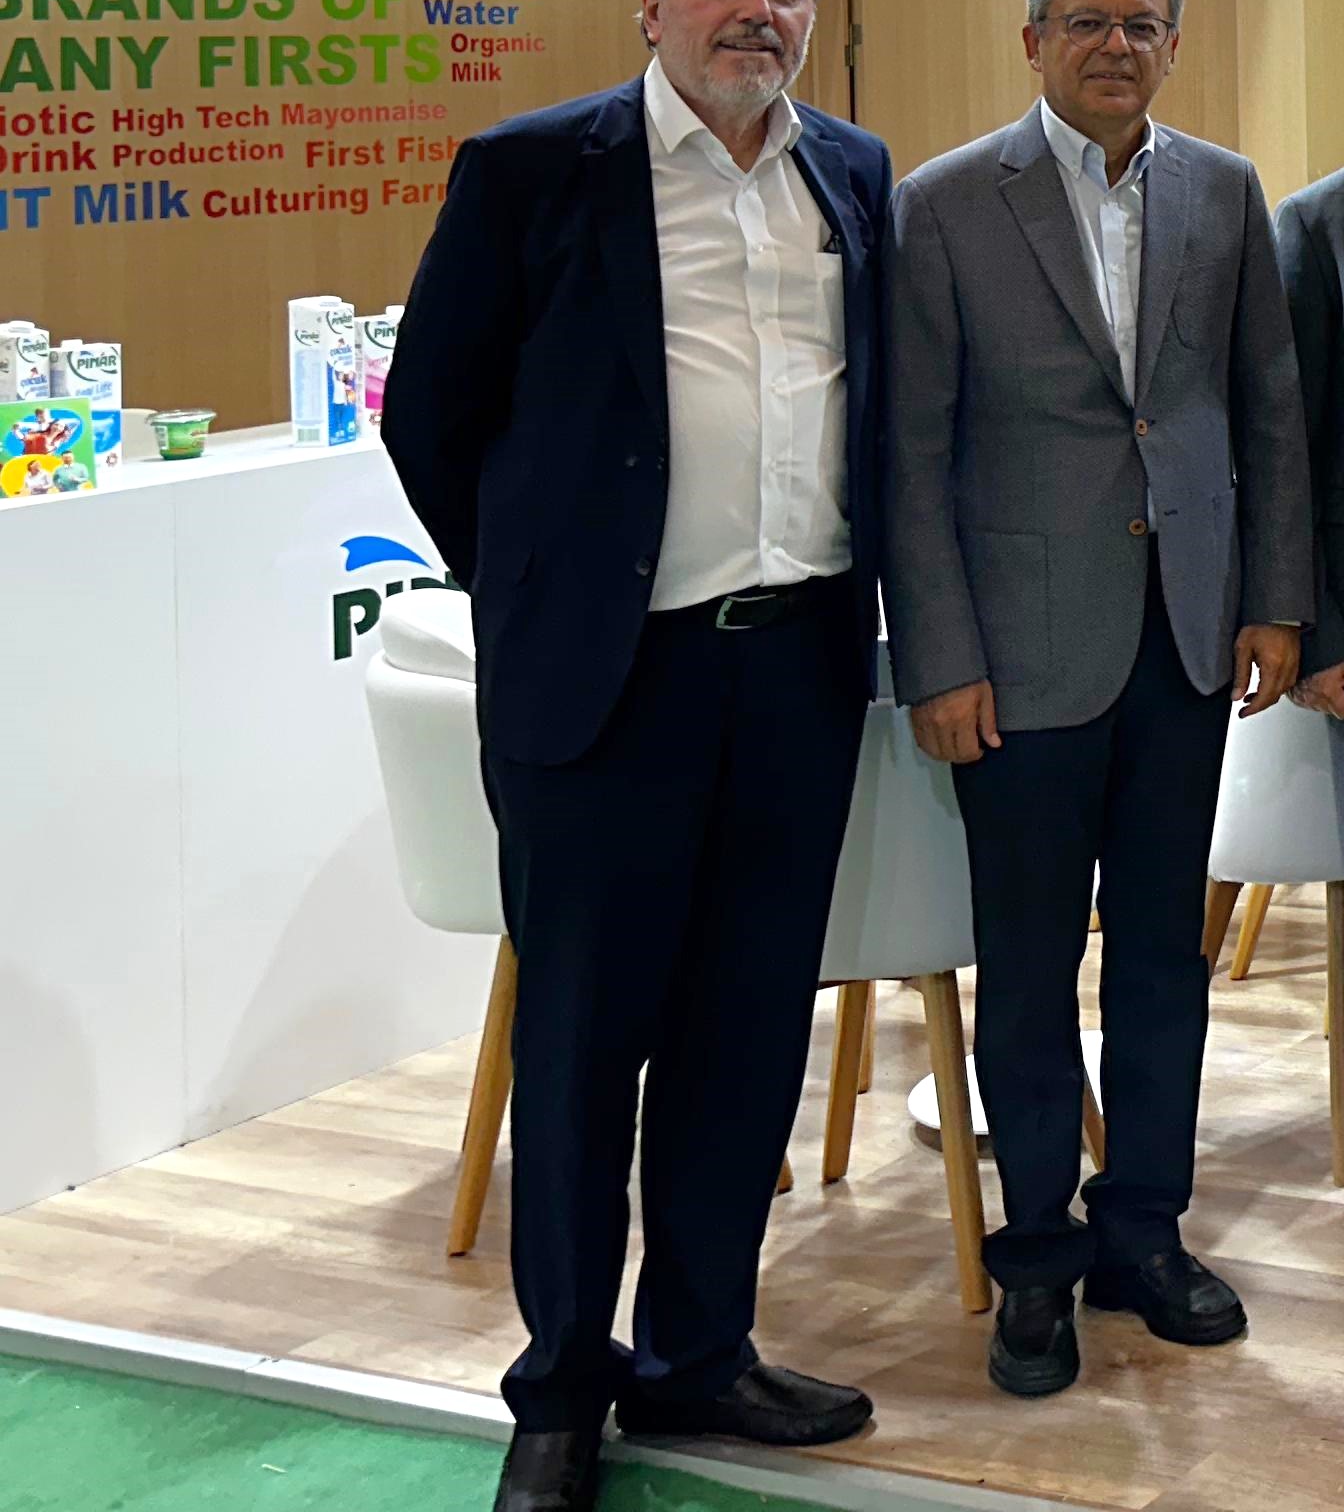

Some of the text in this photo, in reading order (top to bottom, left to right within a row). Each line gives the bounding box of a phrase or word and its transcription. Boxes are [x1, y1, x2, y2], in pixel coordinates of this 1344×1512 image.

[423, 0, 519, 25] Water
[451, 32, 545, 57] Organic
[0, 34, 442, 92] ANY FIRSTS
[451, 62, 502, 82] Milk
[113, 107, 184, 137] High
[197, 103, 269, 129] Tech
[281, 98, 447, 131] Mayonnaise
[113, 139, 284, 167] Production
[306, 139, 385, 168] First
[74, 180, 190, 225] Milk
[203, 185, 369, 221] Culturing
[374, 326, 396, 338] PIN
